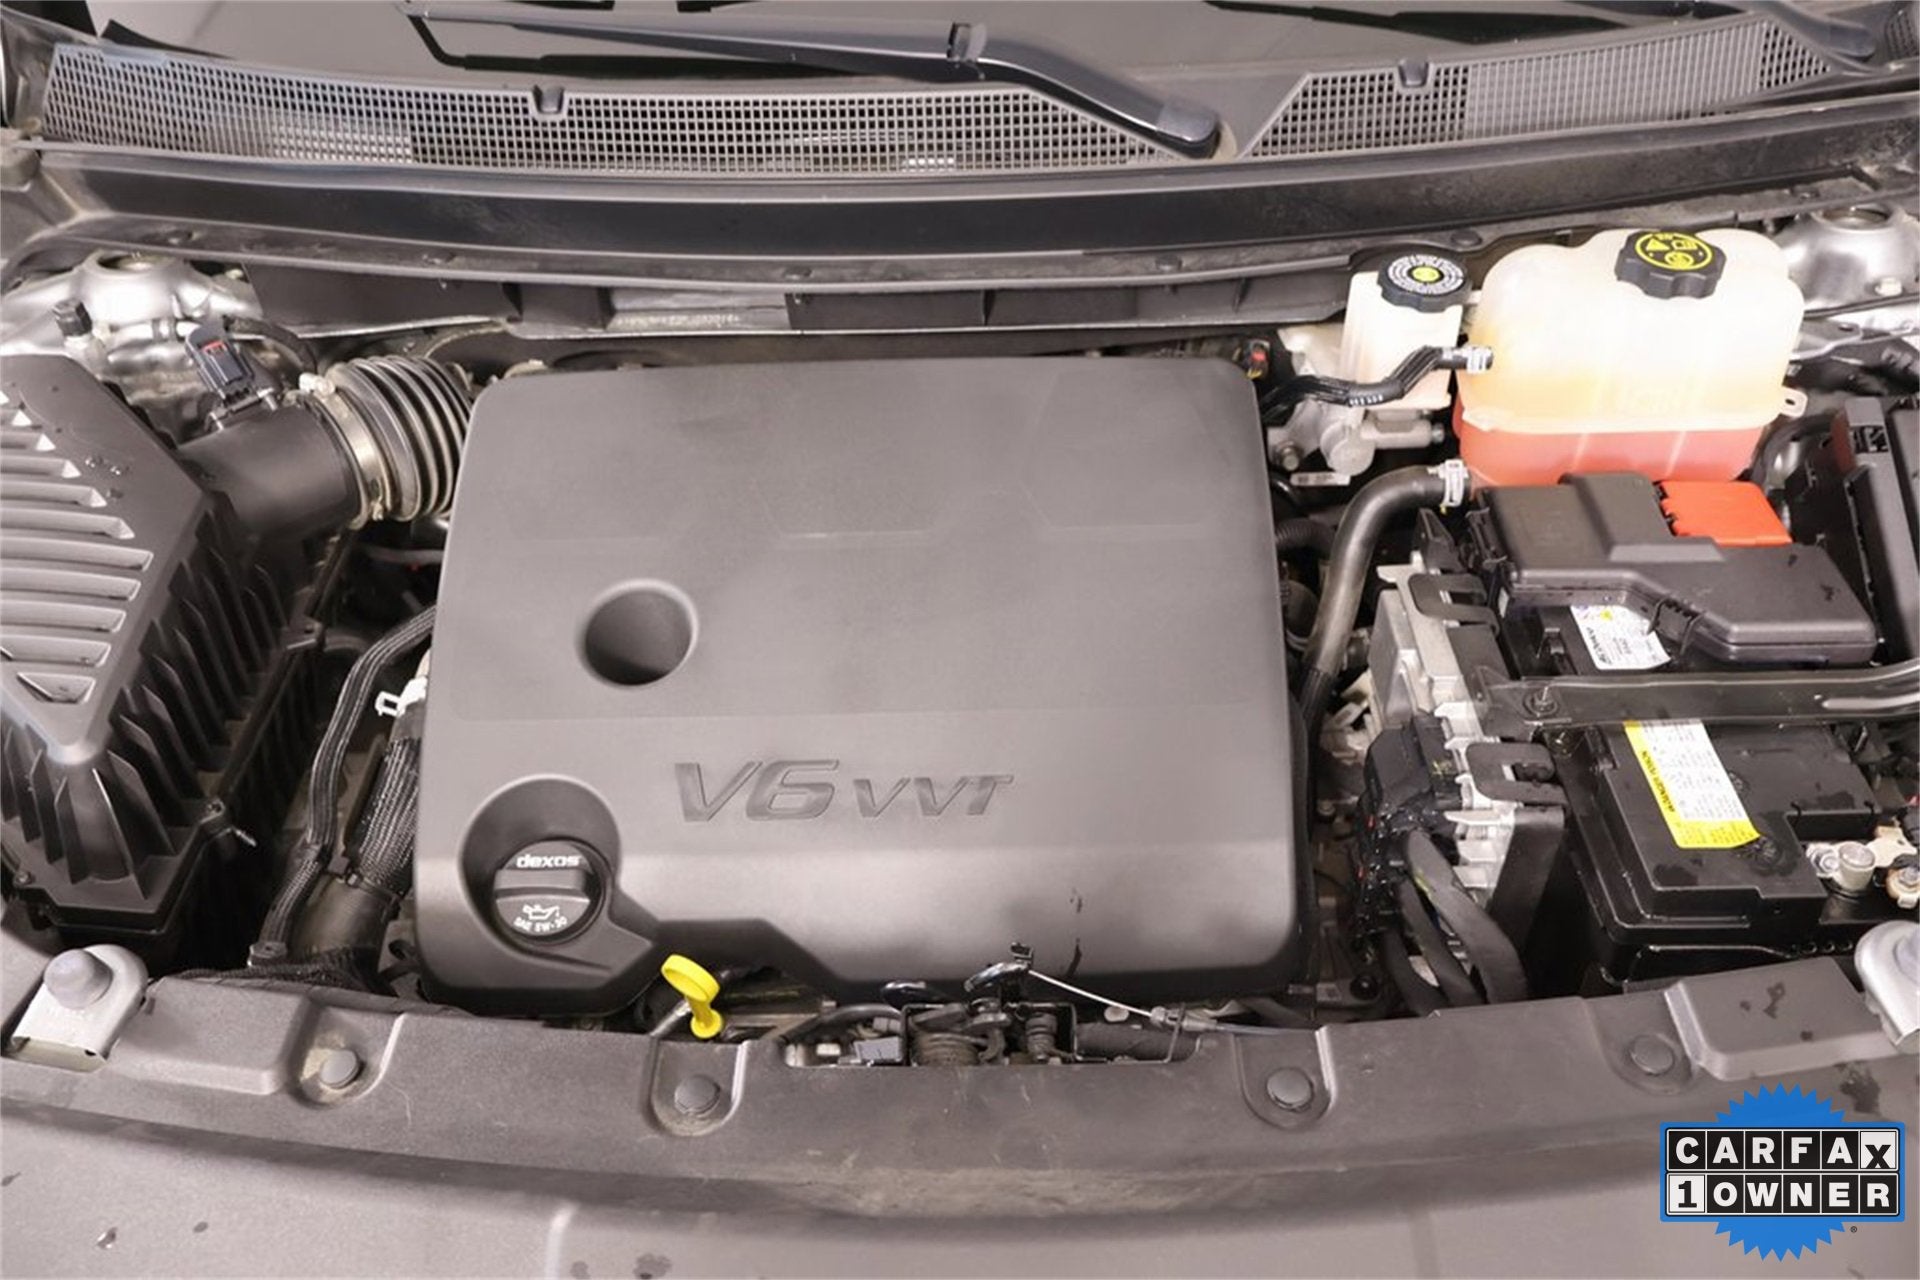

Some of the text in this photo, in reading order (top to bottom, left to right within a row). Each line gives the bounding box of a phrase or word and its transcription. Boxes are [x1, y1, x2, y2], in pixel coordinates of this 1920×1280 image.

[673, 758, 1014, 823] V6 VVT
[516, 853, 582, 869] dexos
